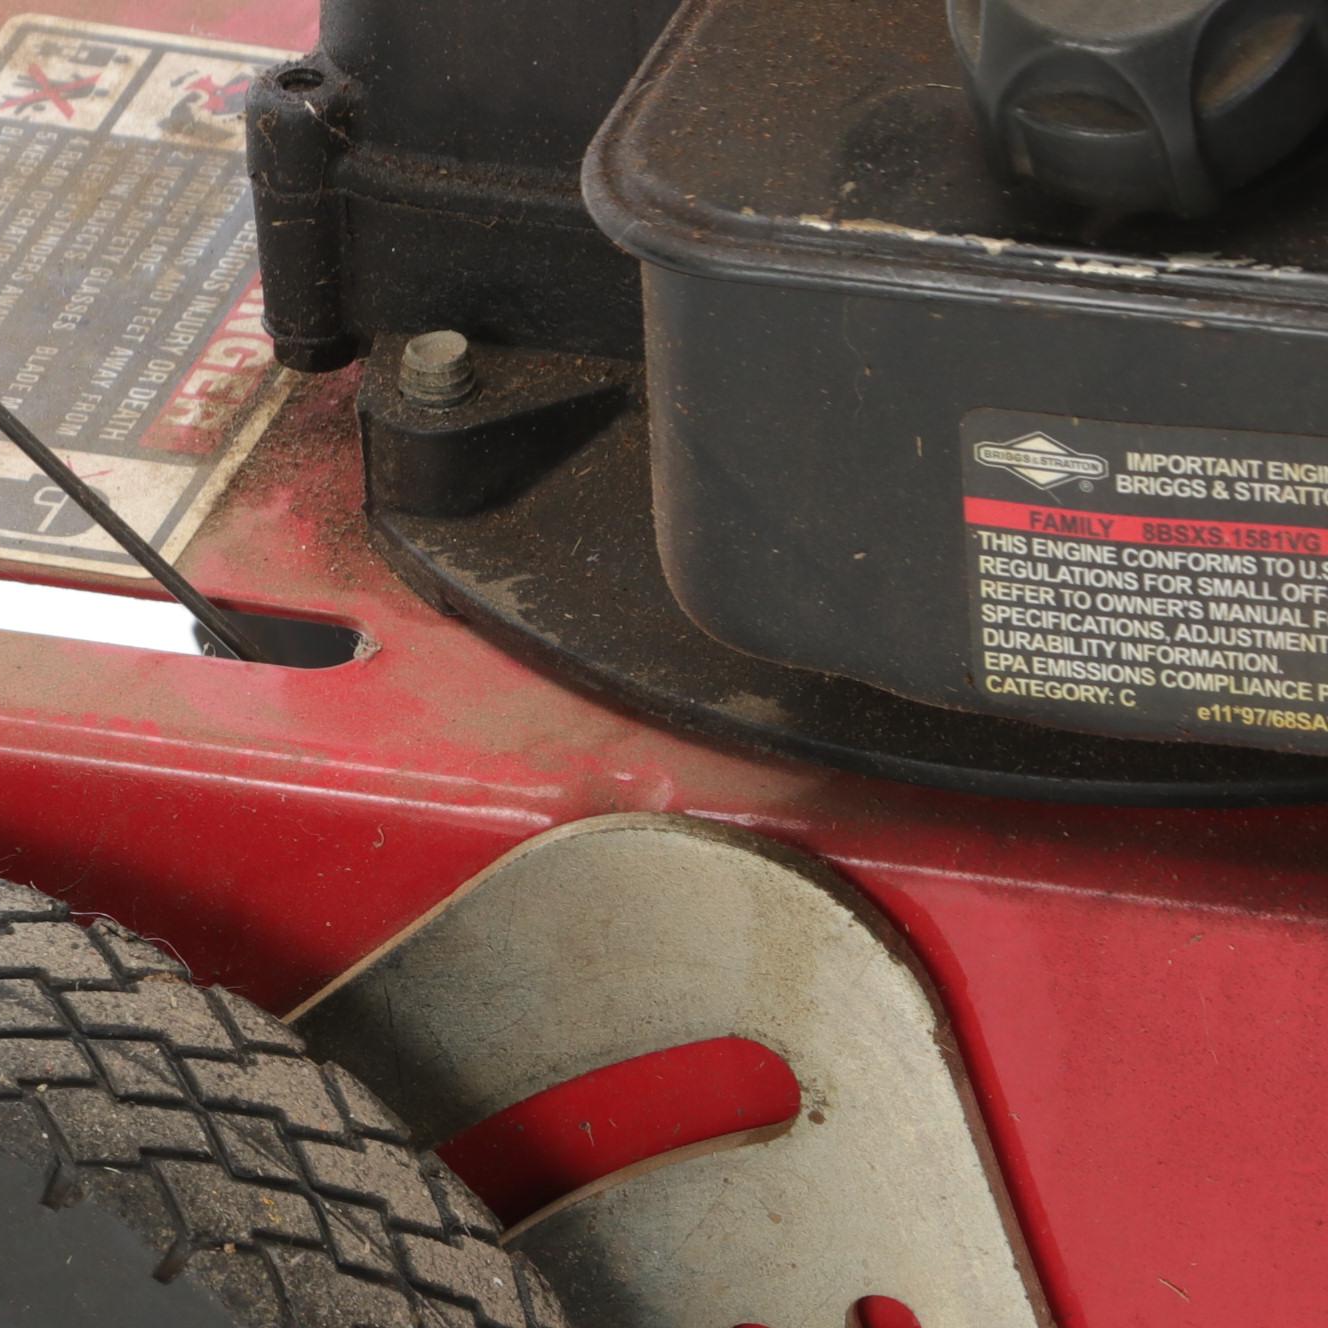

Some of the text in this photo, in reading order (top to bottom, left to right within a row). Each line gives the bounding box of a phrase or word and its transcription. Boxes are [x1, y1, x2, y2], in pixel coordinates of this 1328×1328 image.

[96, 209, 155, 264] SAFETY
[170, 216, 226, 267] HANDS
[118, 304, 164, 341] FEET
[156, 294, 221, 355] INJURY
[5, 345, 60, 393] BLADE
[85, 345, 136, 389] AWAY
[136, 358, 178, 383] OR
[51, 392, 104, 437] FROM
[96, 386, 157, 442] DEATH
[1116, 474, 1207, 499] BRIGGS
[1212, 480, 1230, 500] &
[1126, 451, 1263, 479] IMPORTANT
[977, 530, 1028, 555] THIS
[1032, 537, 1118, 565] ENGINE
[1122, 548, 1258, 576] CONFORMS
[1261, 556, 1295, 578] TO
[1029, 511, 1321, 552] FAMILY 8BSXS.1581VG
[978, 555, 1140, 591] REGULATIONS
[1143, 572, 1194, 595] FOR
[1197, 577, 1278, 601] SMALL
[980, 579, 1057, 607] REFER
[1059, 588, 1092, 610] TO
[1096, 592, 1204, 620] OWNER'S
[1208, 601, 1311, 628] MANUAL
[981, 603, 1170, 644] SPECIFICATIONS,
[983, 627, 1285, 675] DURABILITY INFORMATION.
[984, 651, 1030, 675] EPA
[1032, 656, 1156, 687] EMISSIONS
[1161, 669, 1314, 702] COMPLIANCE
[985, 674, 1137, 708] CATEGORY: C
